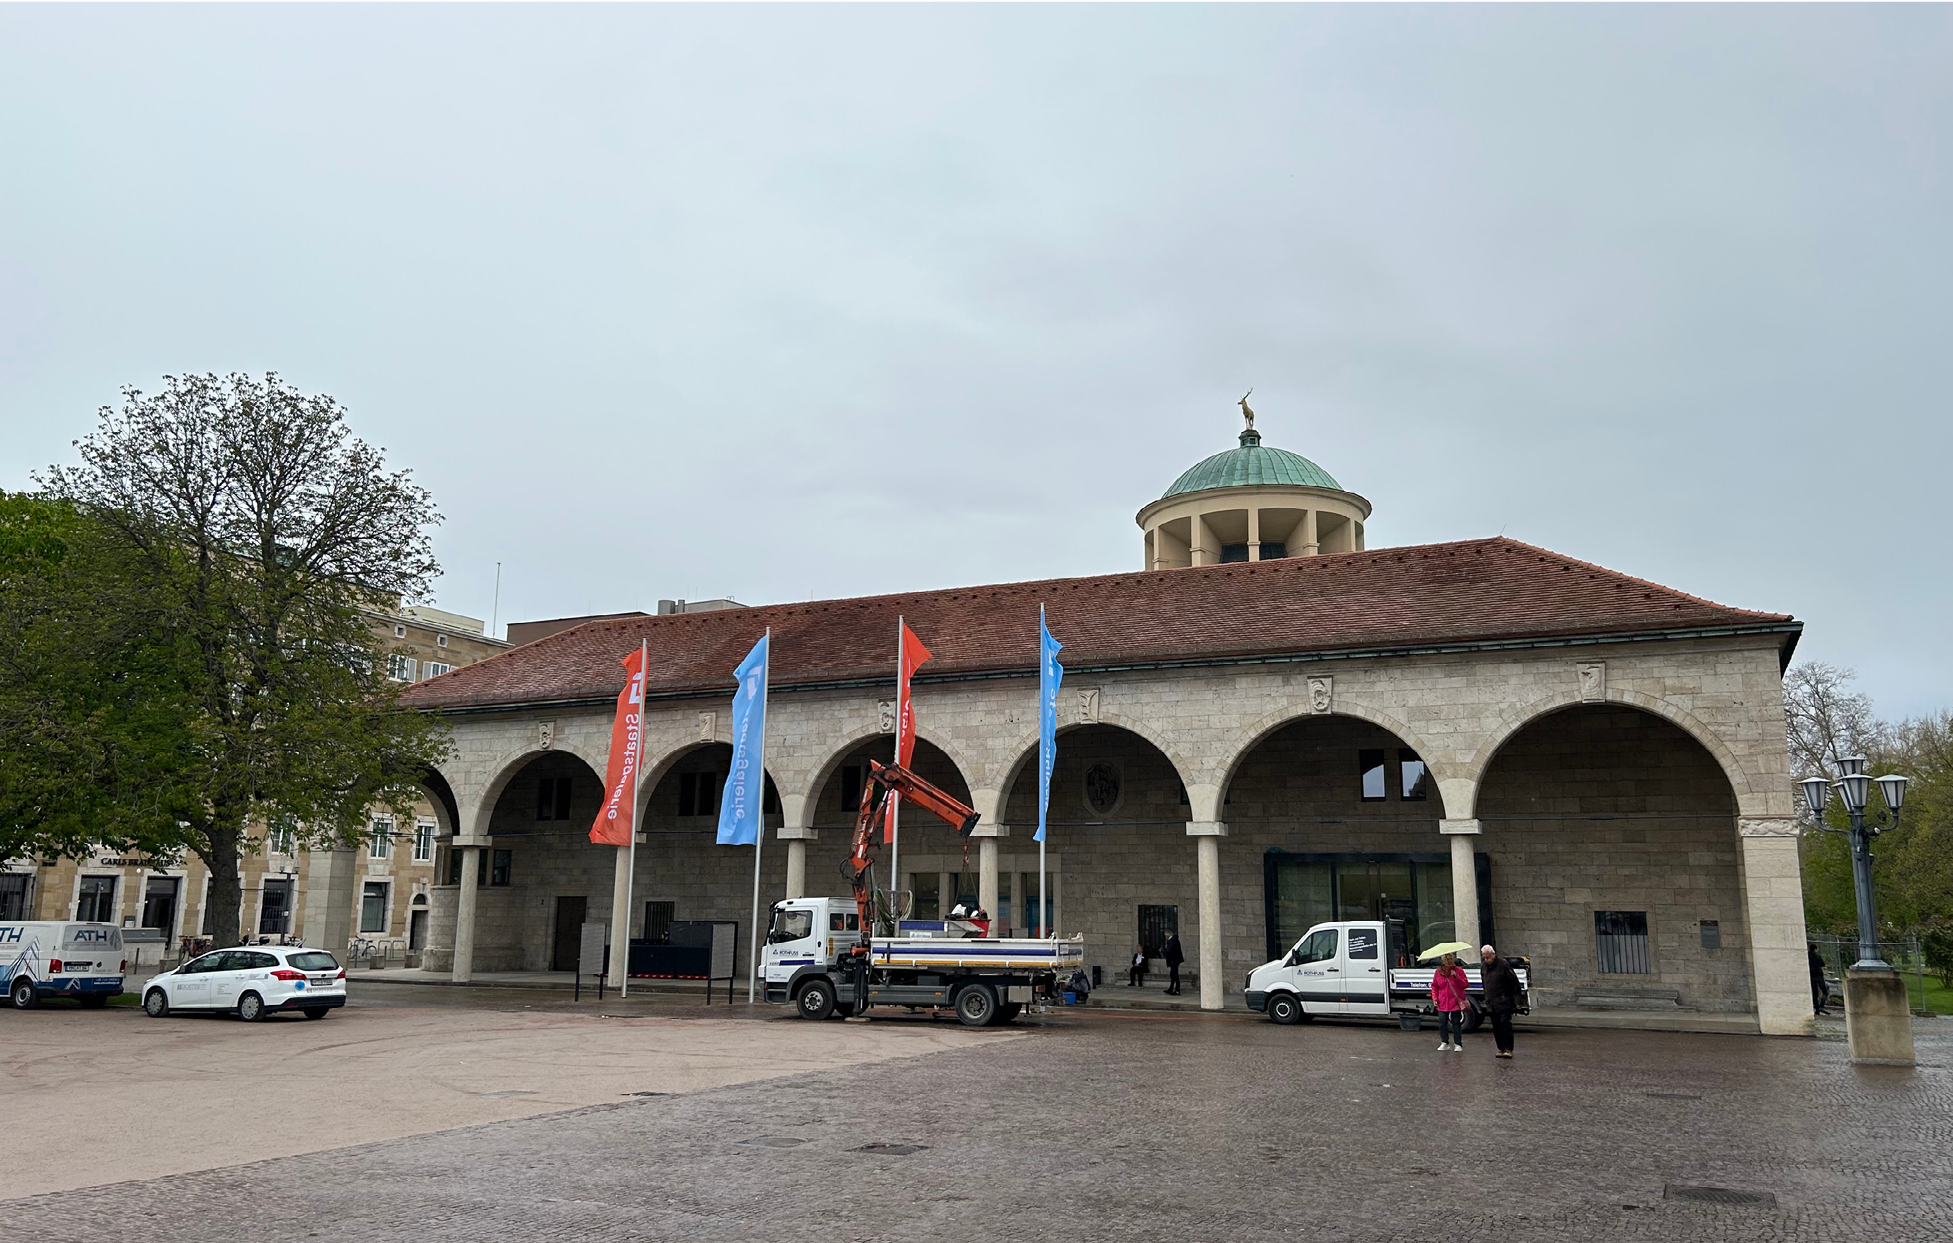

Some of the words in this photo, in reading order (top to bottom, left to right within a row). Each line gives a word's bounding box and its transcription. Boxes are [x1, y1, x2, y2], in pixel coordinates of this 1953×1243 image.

[101, 858, 127, 866] CARLS
[0, 927, 24, 942] TH
[73, 930, 107, 941] ATH
